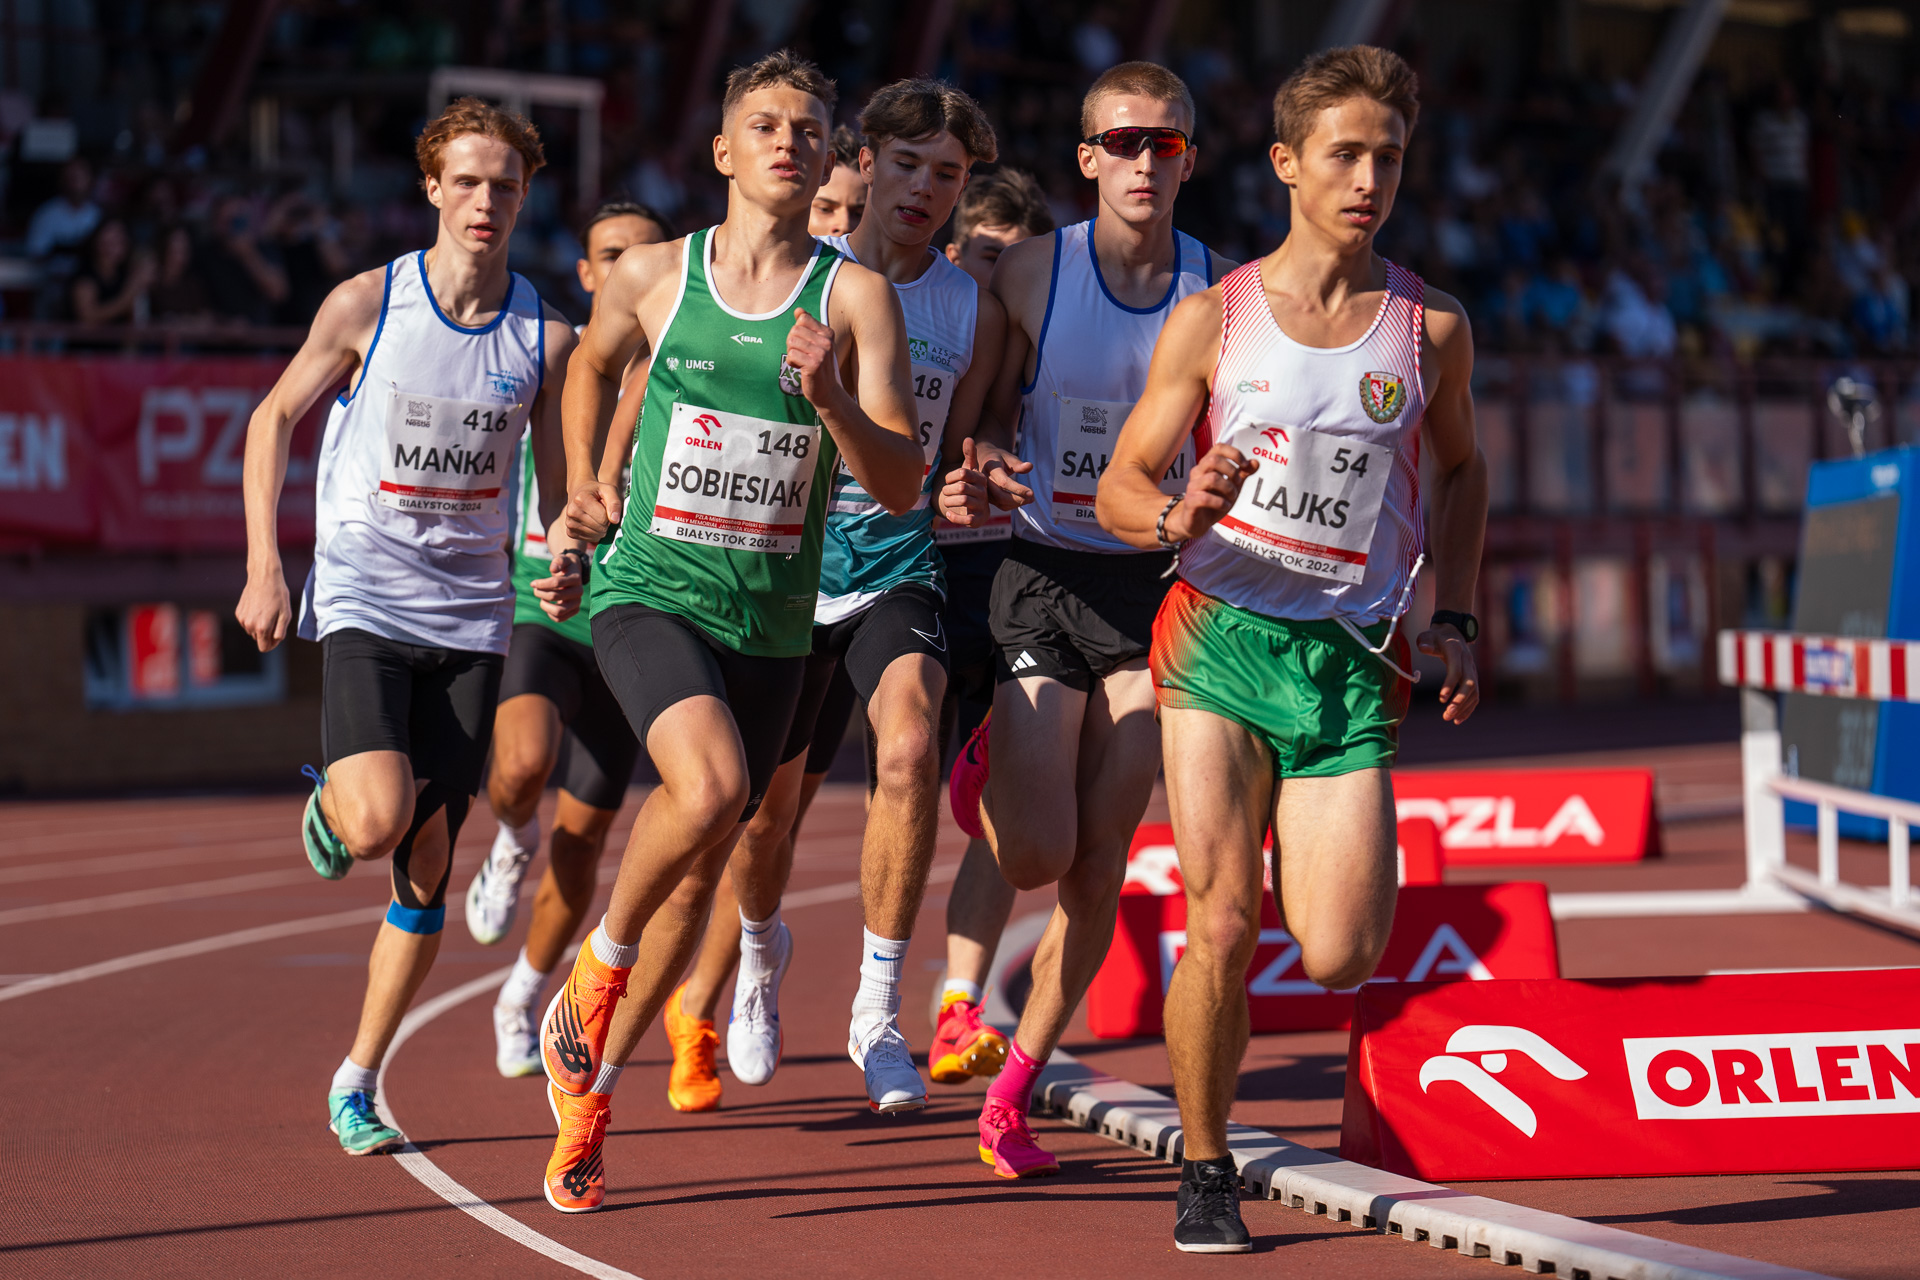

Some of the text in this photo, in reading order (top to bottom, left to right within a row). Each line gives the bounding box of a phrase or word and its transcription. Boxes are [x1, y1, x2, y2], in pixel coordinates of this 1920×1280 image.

[685, 359, 715, 371] UMCS
[1237, 379, 1270, 393] esa
[463, 409, 508, 432] 416
[685, 436, 723, 451] ORLEN
[757, 430, 811, 459] 148
[1252, 446, 1289, 466] ORLEN
[394, 443, 496, 475] MAŃKA
[1330, 448, 1370, 478] 54
[666, 462, 807, 508] SOBIESIAK
[399, 498, 482, 512] BIAŁYSTOK 2024
[1251, 477, 1350, 529] LAJKS
[676, 526, 778, 549] BIAŁYSTOK 2024
[1233, 536, 1338, 575] BIAŁYSTOK 2024
[1646, 1043, 1920, 1108] ORLEN
